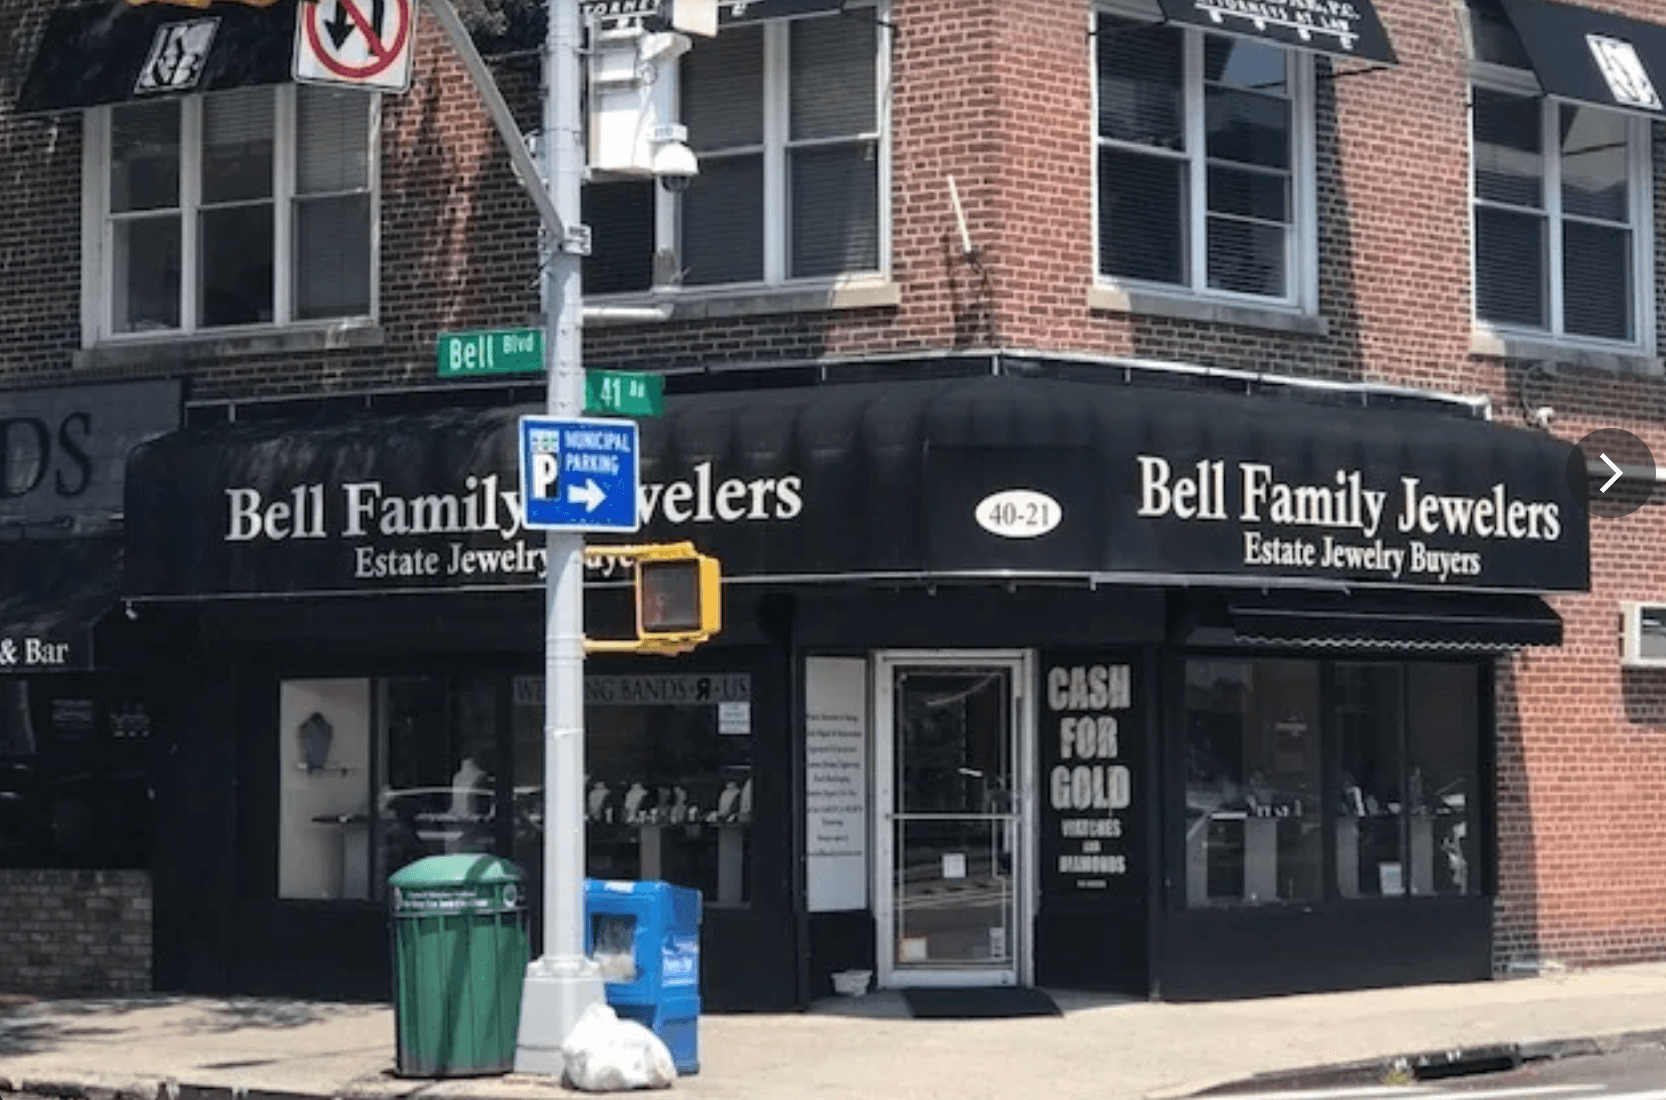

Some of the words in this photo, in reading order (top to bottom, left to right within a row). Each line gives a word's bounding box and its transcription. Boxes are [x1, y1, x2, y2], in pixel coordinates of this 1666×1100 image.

[450, 334, 494, 370] Bell
[601, 377, 621, 408] 41
[564, 430, 631, 453] MUNICIPAL
[533, 452, 558, 499] P
[565, 451, 620, 476] PARKING
[224, 482, 327, 541] Bell
[341, 473, 521, 540] Family
[989, 502, 1049, 527] 40-21
[1136, 455, 1228, 519] Bell
[1238, 462, 1387, 538] Family
[1398, 475, 1561, 541] Jewelers
[354, 546, 440, 578] Estate
[1244, 530, 1315, 566] Estate
[1321, 535, 1404, 578] Jewelry
[1409, 541, 1481, 582] Buyers
[0, 637, 18, 665] &
[25, 637, 69, 665] Bar
[1048, 664, 1131, 711] CASH
[1060, 716, 1118, 759] FOR
[1051, 765, 1131, 810] GOLD
